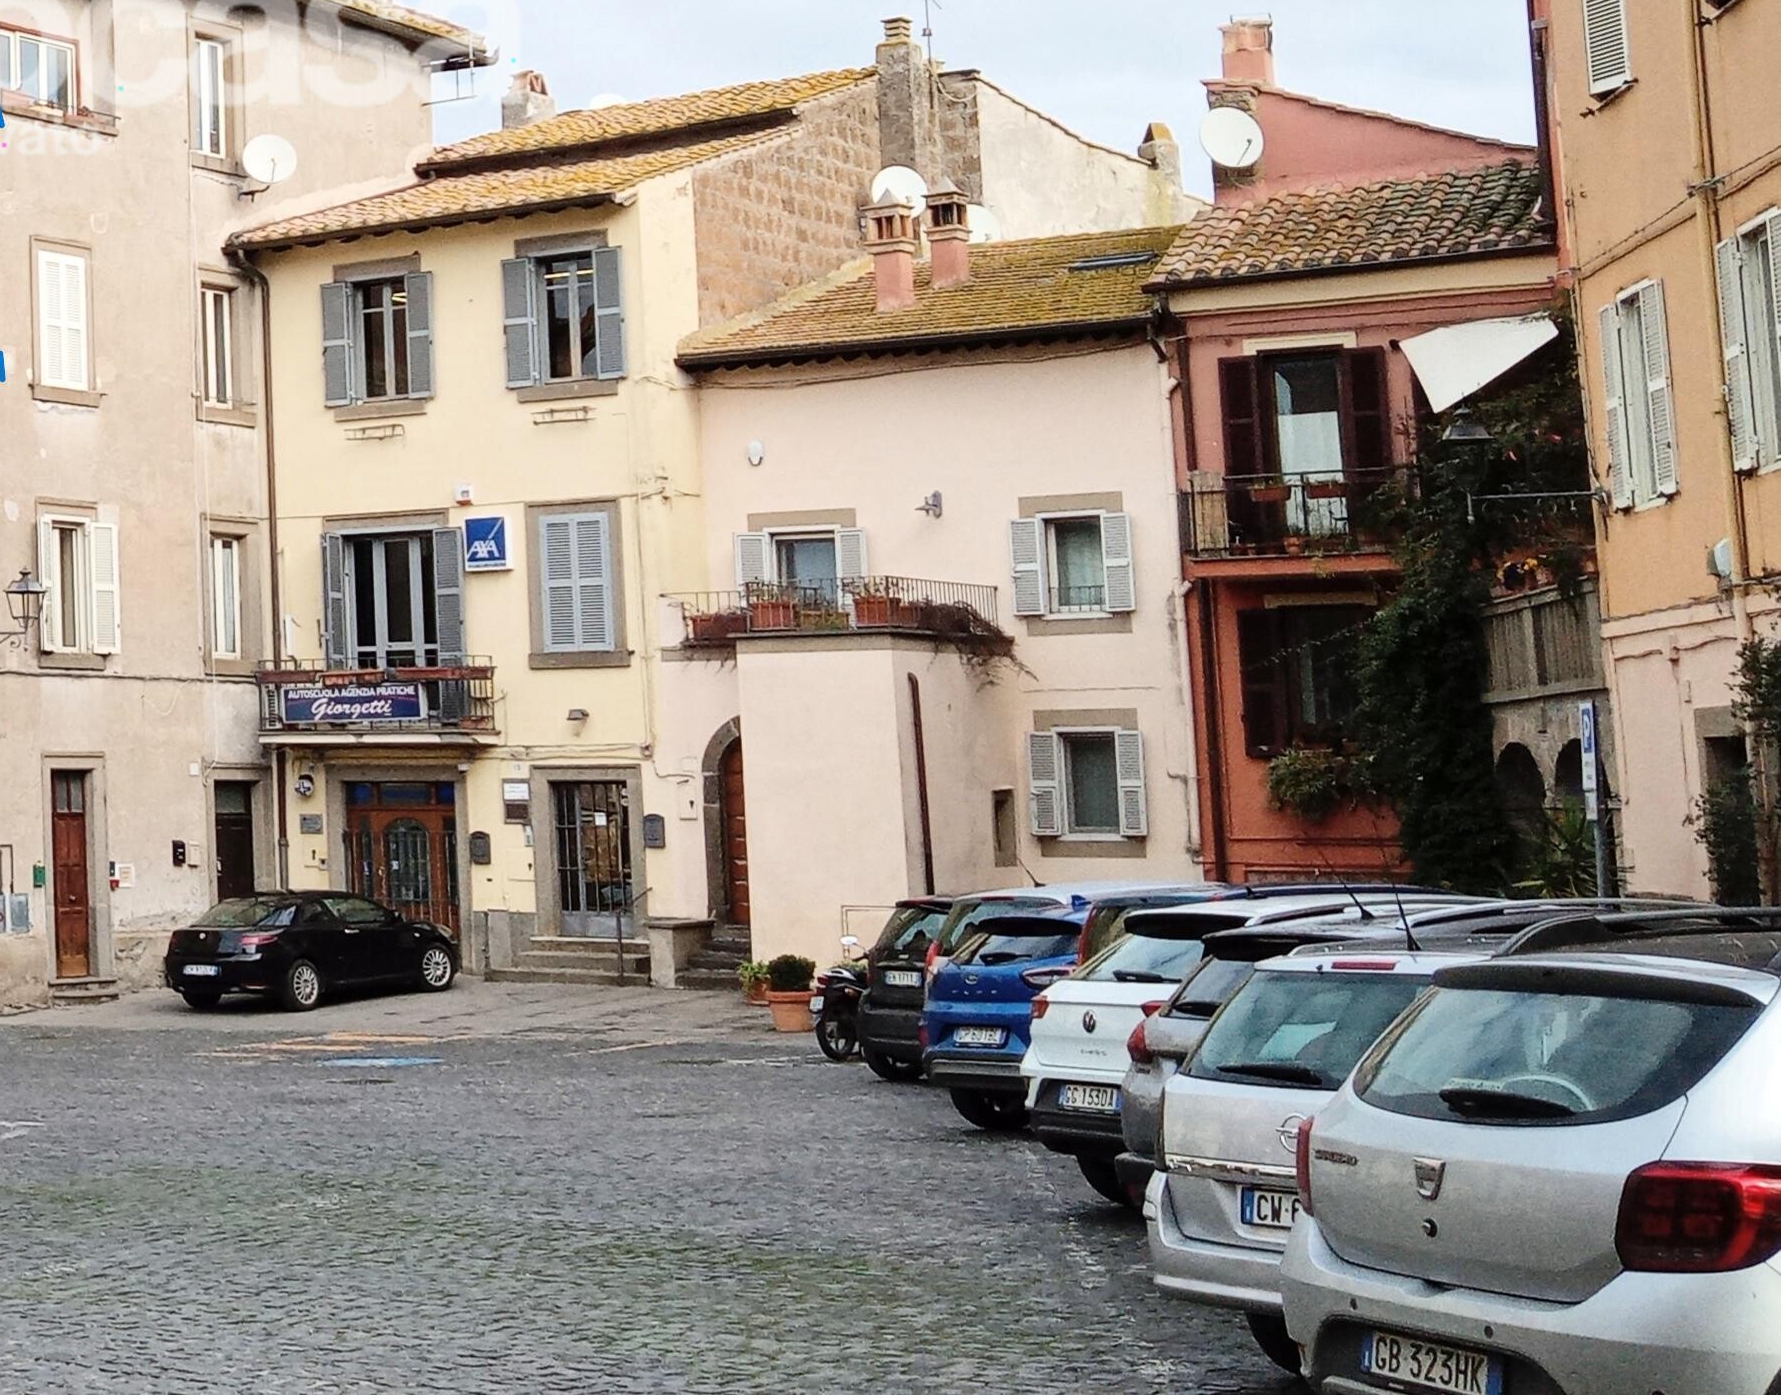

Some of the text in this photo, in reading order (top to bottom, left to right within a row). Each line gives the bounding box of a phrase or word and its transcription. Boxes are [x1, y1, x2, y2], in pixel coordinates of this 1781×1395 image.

[468, 539, 500, 559] AXA
[287, 685, 416, 700] AUTOSCUOLA AGENZIA PRATICHE
[311, 697, 392, 722] Giorgetti
[1374, 1335, 1486, 1394] GB 323HK
